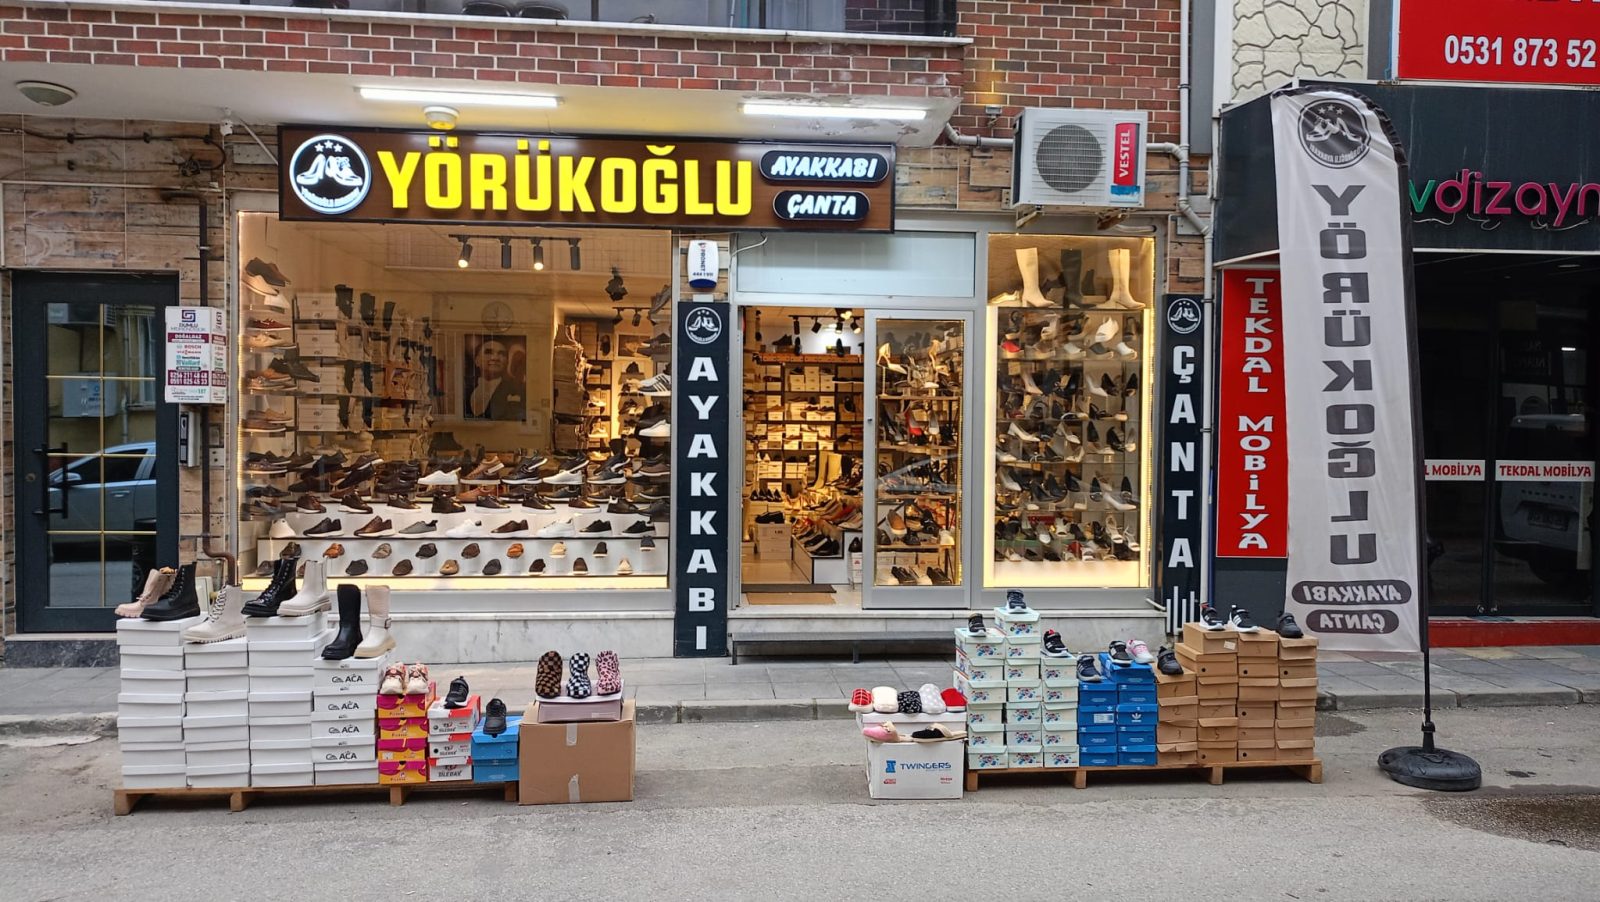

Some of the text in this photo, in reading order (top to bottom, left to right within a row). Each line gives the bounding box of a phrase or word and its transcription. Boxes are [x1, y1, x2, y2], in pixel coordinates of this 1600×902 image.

[1444, 35, 1597, 68] 0531 873 52
[770, 155, 878, 178] AYAKKABI
[1119, 129, 1131, 178] VESTEL
[377, 136, 752, 216] YÖRÜKOĞLU
[787, 194, 857, 218] ÇANTA
[1242, 278, 1275, 393] TEKDAL
[1168, 345, 1196, 568] ÇANTA
[1432, 462, 1482, 476] MOBİLYA
[1499, 463, 1592, 477] TEKDAL MOBİLYA
[686, 356, 719, 650] AYAKKABI
[900, 761, 952, 770] TWINGERS
